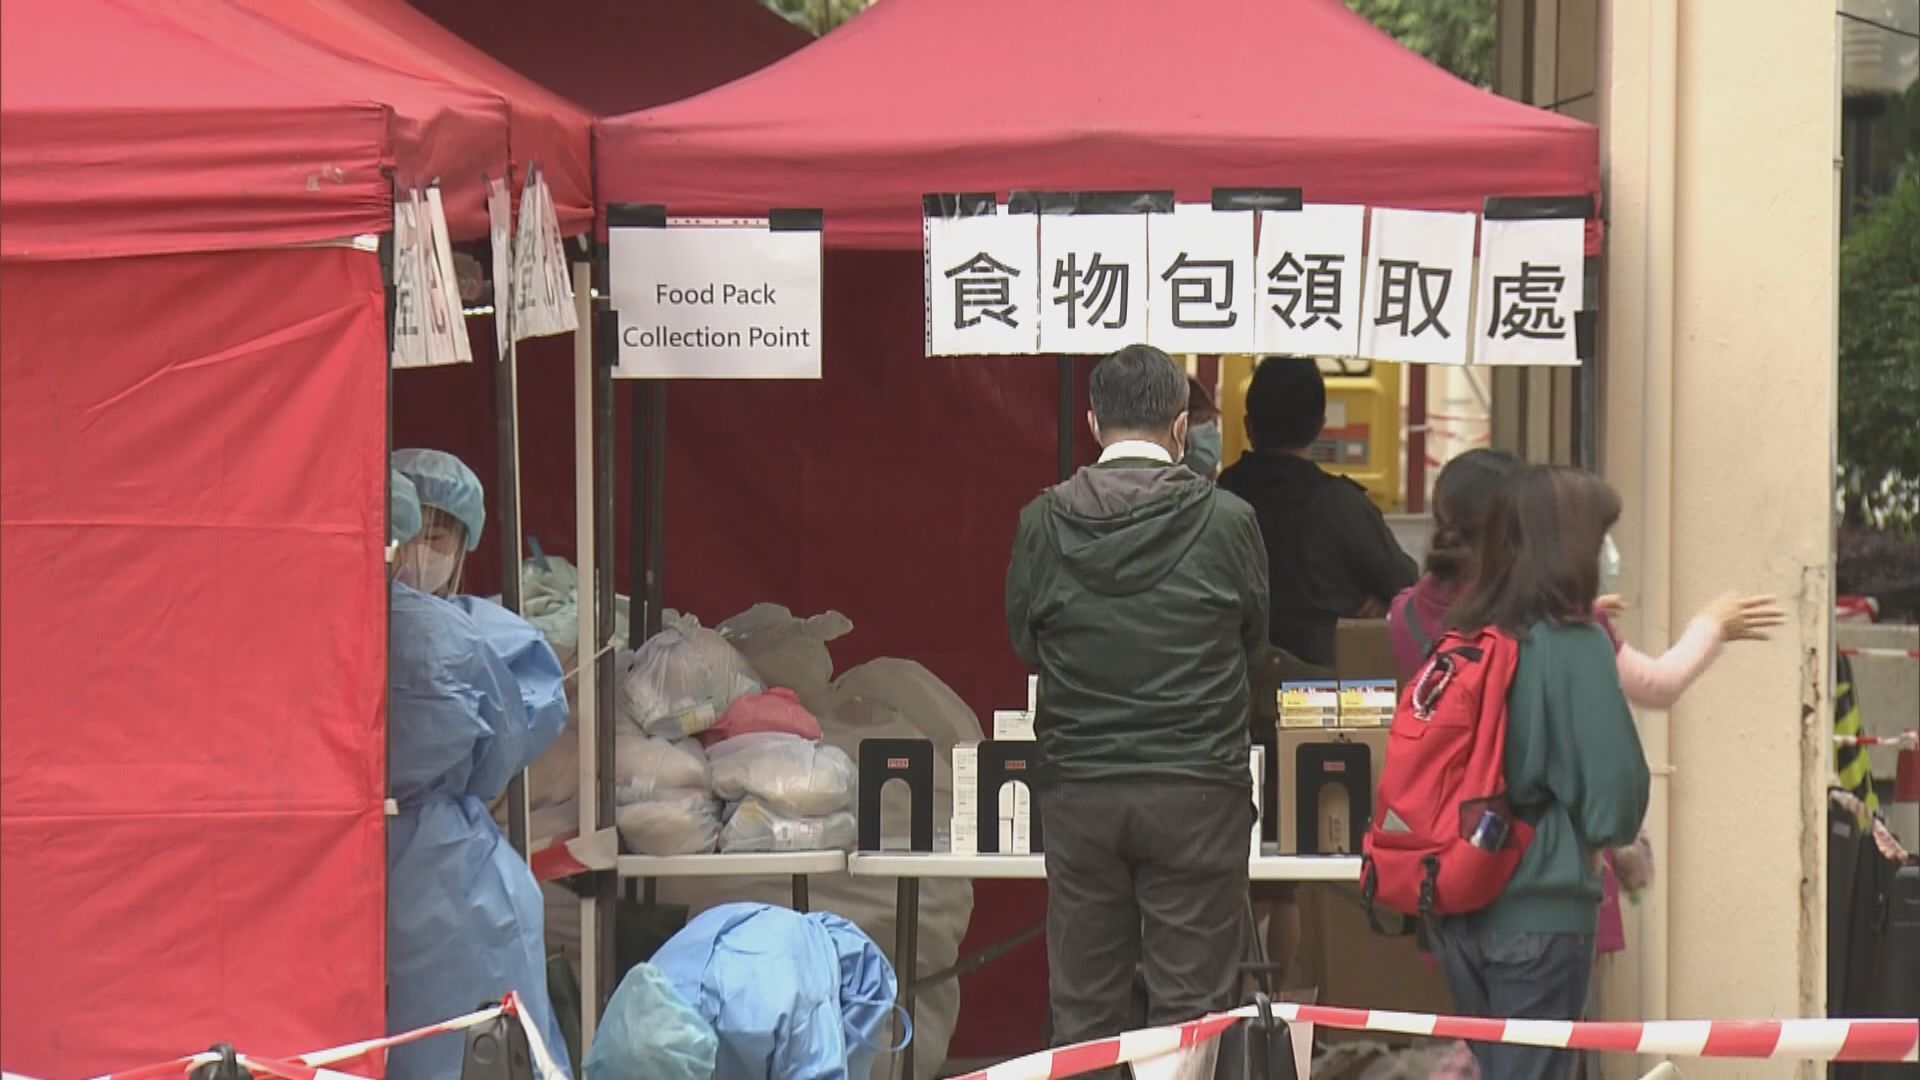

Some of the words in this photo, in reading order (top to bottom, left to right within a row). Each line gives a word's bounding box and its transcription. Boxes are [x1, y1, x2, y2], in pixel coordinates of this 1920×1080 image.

[656, 283, 714, 305] Food
[723, 283, 776, 305] Pack
[944, 250, 1568, 340] 食物包領取處
[623, 325, 741, 348] Collection
[749, 325, 811, 348] Point
